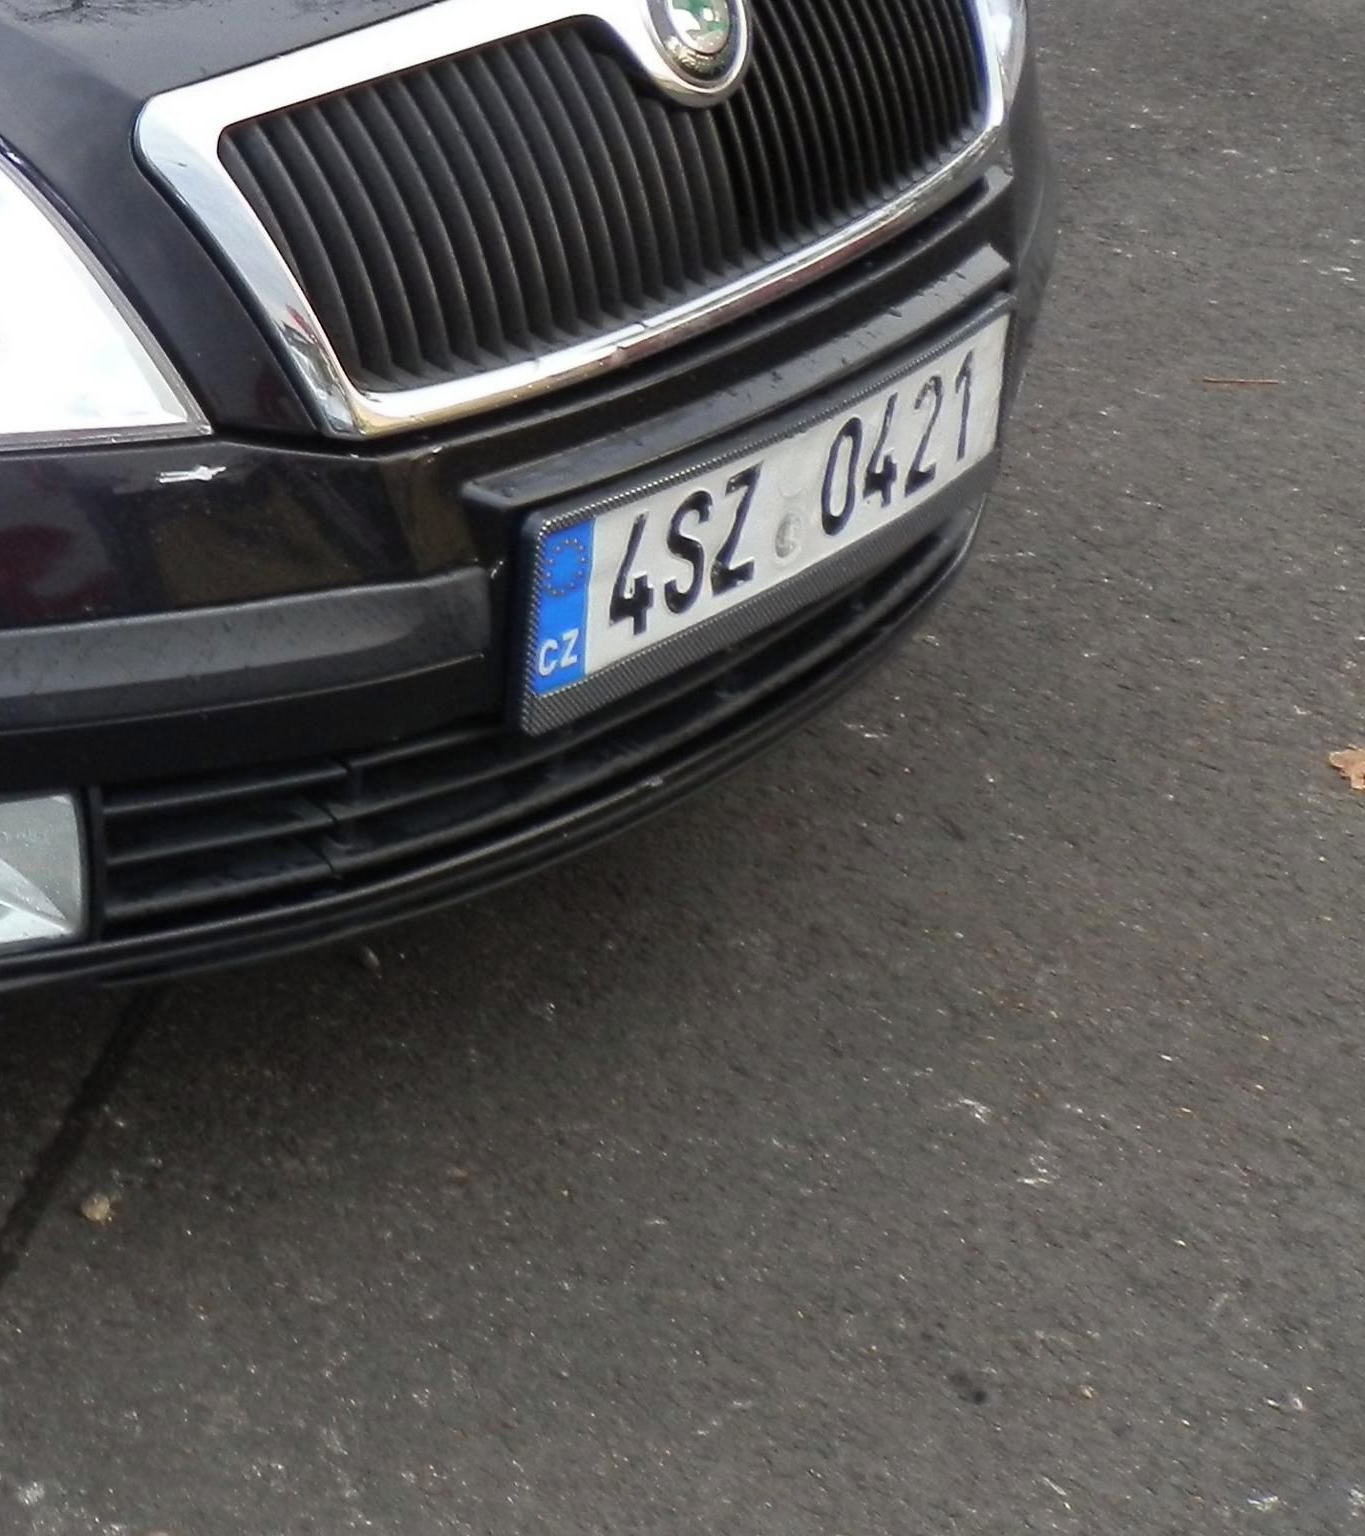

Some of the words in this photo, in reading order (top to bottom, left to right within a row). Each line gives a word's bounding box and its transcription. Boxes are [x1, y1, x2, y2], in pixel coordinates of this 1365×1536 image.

[608, 459, 765, 636] 4SZ
[821, 350, 974, 537] 0421
[538, 627, 580, 677] CZ
